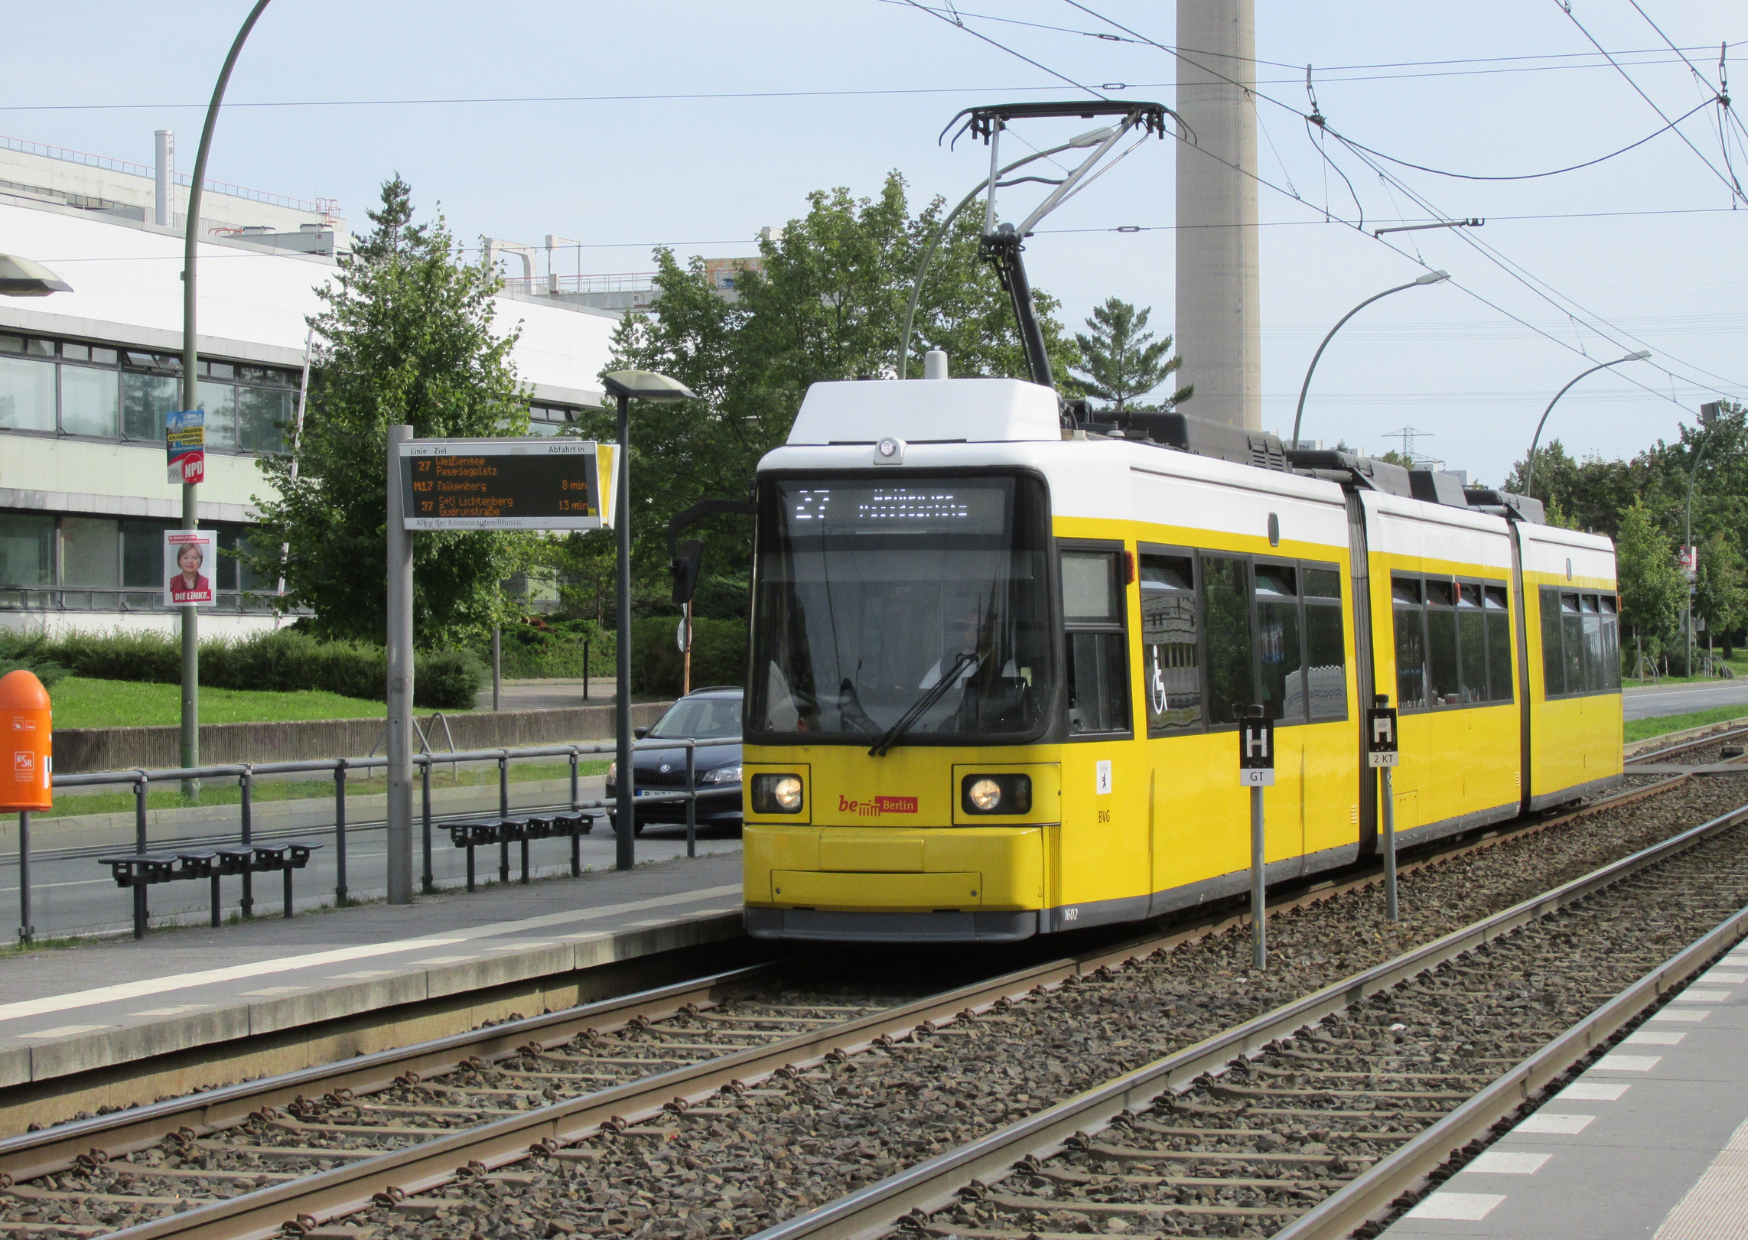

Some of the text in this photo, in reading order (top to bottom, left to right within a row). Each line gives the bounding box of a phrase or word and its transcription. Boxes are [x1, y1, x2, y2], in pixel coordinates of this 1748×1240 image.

[410, 446, 447, 455] Linie Ziel
[548, 445, 585, 454] Abfahrt in
[418, 461, 431, 472] 27
[436, 457, 486, 466] Weißensee
[184, 461, 203, 479] NPD
[436, 466, 498, 476] Pasedagplatz
[413, 481, 434, 492] M17
[437, 481, 487, 492] Falkenberg
[561, 479, 588, 490] 8 min
[421, 501, 434, 512] 37
[438, 496, 514, 508] S+U Lichtenberg
[558, 499, 589, 510] 13 min
[439, 506, 500, 517] Gudrunstraße
[174, 592, 187, 601] DIE
[1246, 728, 1268, 758] H
[16, 755, 32, 767] BSR
[1374, 754, 1394, 764] 2 KT
[1250, 771, 1265, 782] GT
[838, 794, 914, 812] be Berlin
[1098, 810, 1110, 823] BVG
[1064, 908, 1079, 921] 1602
